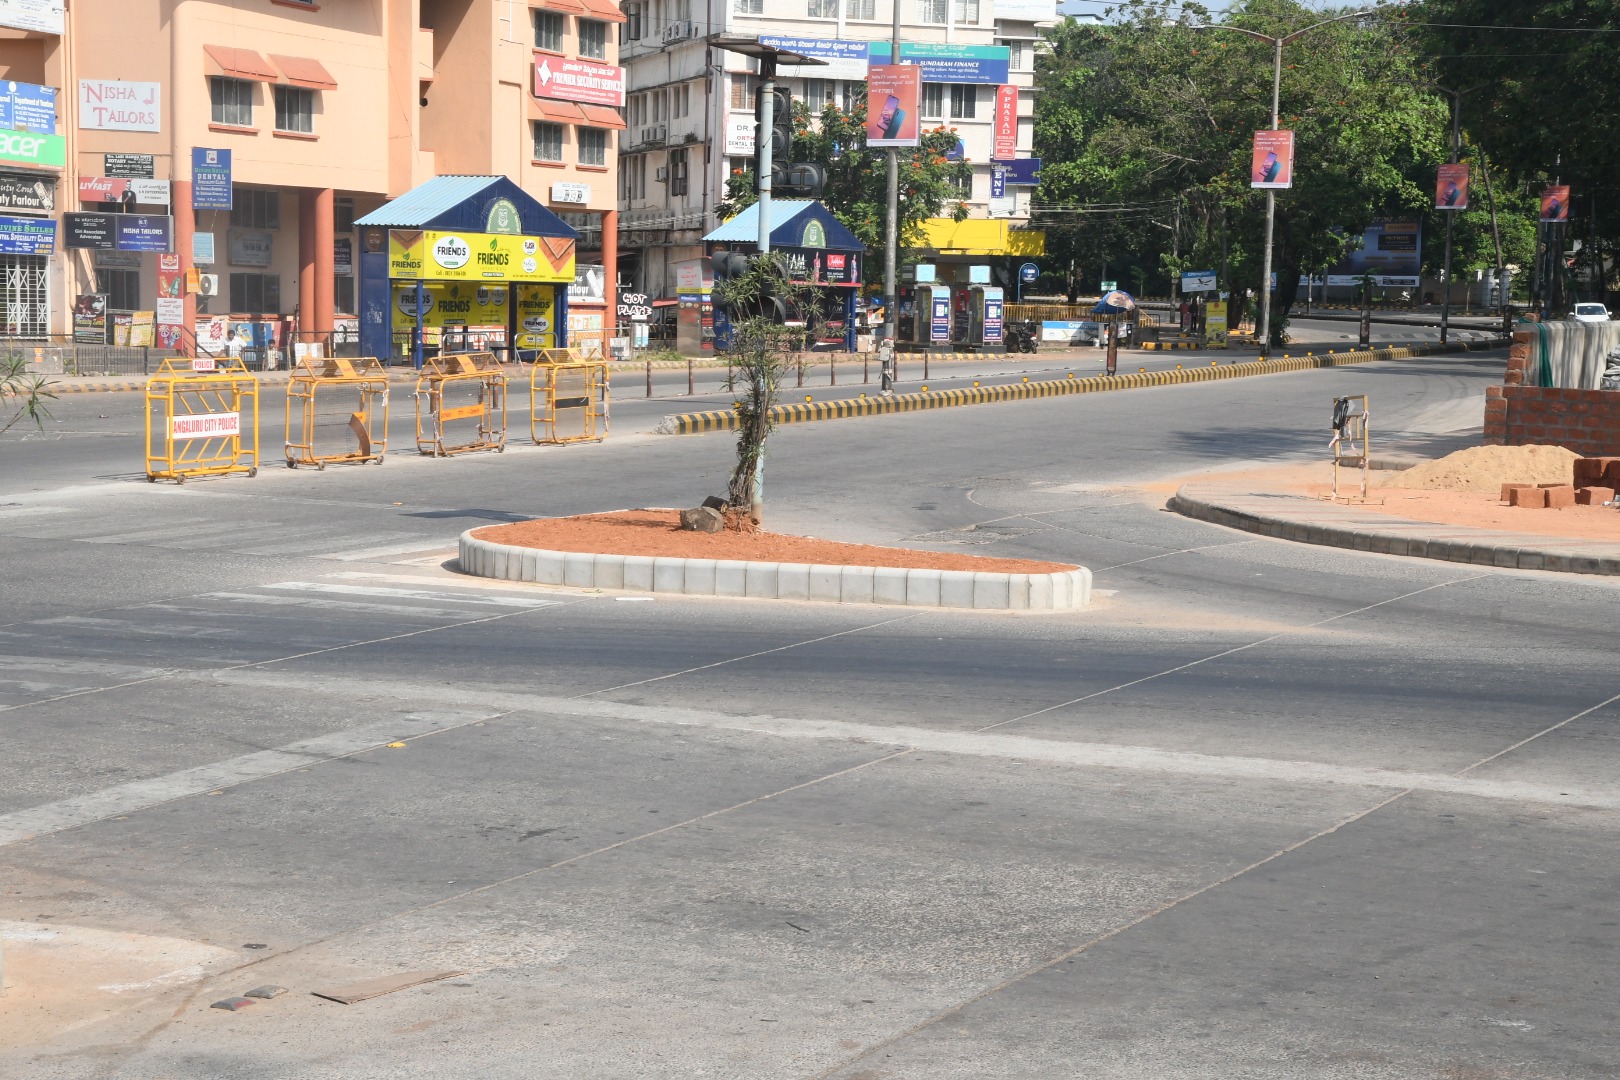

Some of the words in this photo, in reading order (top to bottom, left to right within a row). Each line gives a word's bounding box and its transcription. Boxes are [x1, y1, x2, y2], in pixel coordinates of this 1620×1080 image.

[553, 72, 576, 85] PREMIER
[577, 75, 600, 89] SECURITY
[601, 79, 624, 92] SERVICES
[86, 83, 136, 104] NISHA
[93, 107, 155, 126] TAILORS
[1002, 97, 1011, 134] PRASAD
[16, 184, 33, 193] Zone
[80, 177, 112, 190] LIVFAST
[12, 195, 39, 206] Parlour
[24, 225, 54, 233] SMILES
[11, 233, 37, 241] SPECIALITY
[437, 246, 466, 256] FRIENDS
[478, 253, 509, 265] FRIENDS
[568, 284, 589, 293] arlour
[623, 293, 648, 304] HOT
[438, 301, 470, 312] FRIENDS
[617, 305, 652, 315] PLATE
[174, 419, 203, 433] ANGALURU
[205, 419, 217, 432] CITY
[219, 417, 237, 431] POLICE
